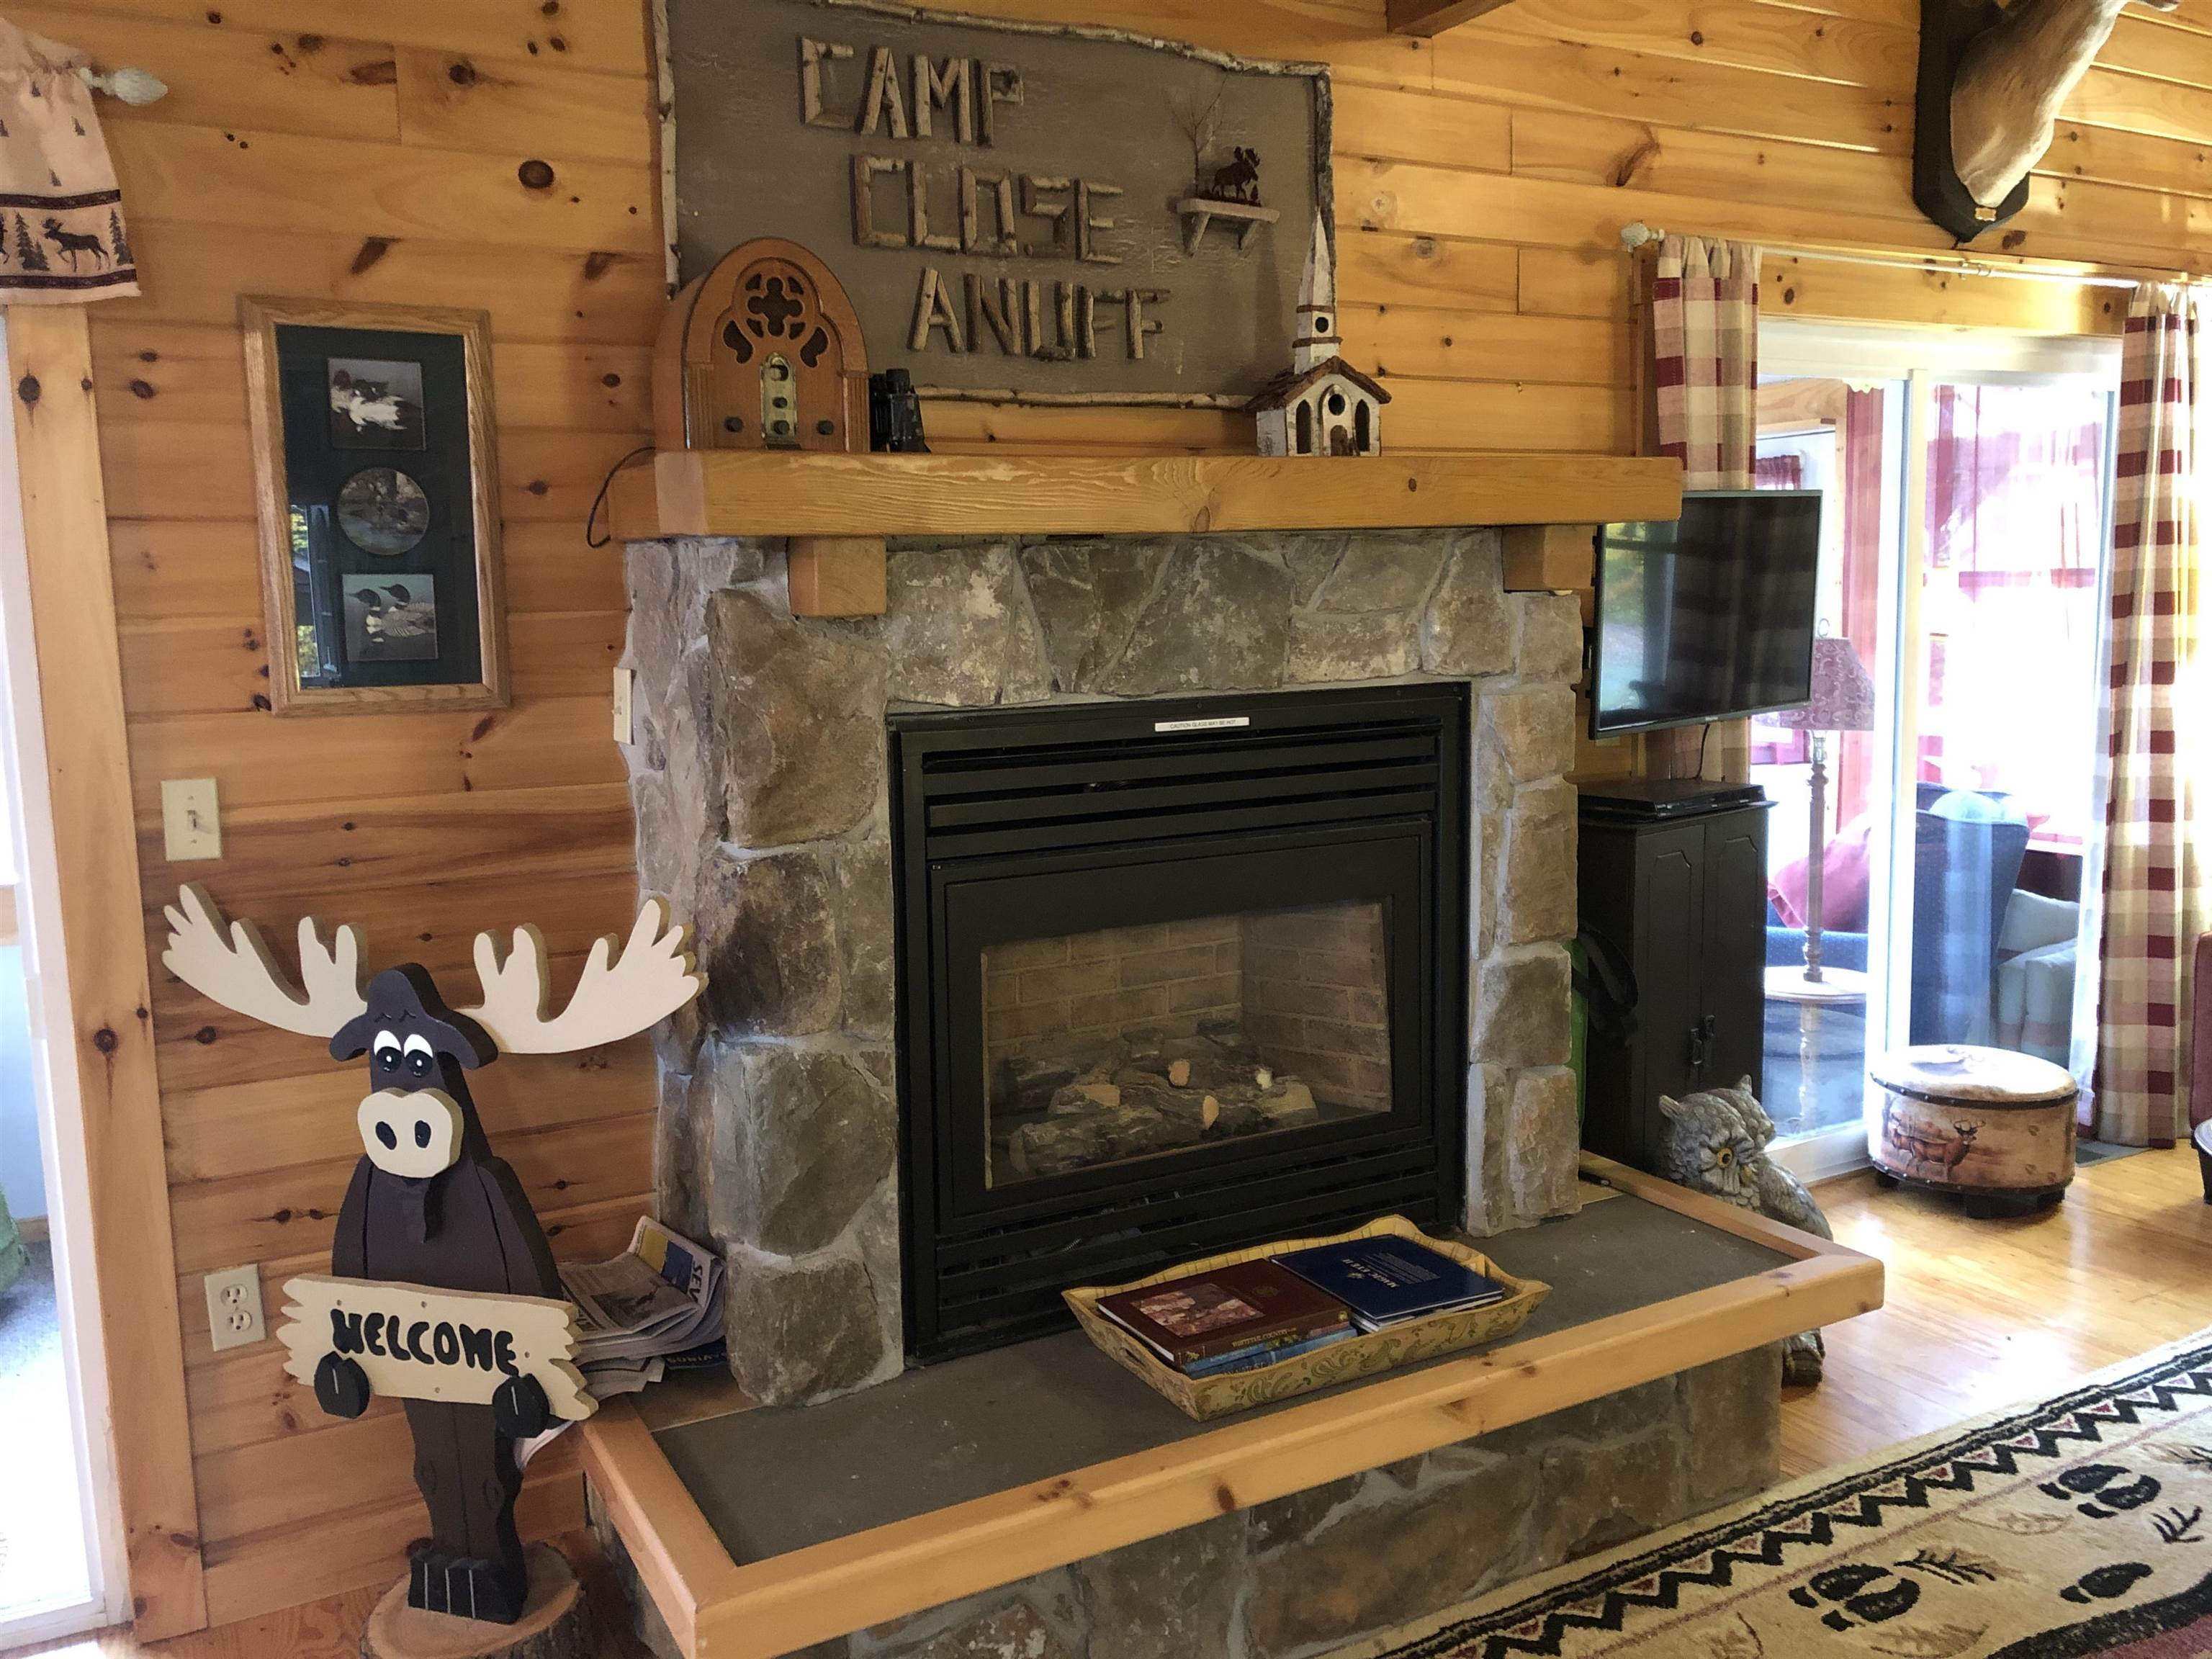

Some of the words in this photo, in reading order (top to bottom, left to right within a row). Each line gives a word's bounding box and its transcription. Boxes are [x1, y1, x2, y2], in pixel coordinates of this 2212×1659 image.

[801, 38, 1024, 146] CAMP
[853, 155, 1123, 264] CLOSE
[909, 266, 1170, 361] ANUFF
[1372, 1272, 1401, 1288] MAGIC
[330, 1308, 519, 1378] WELCOME
